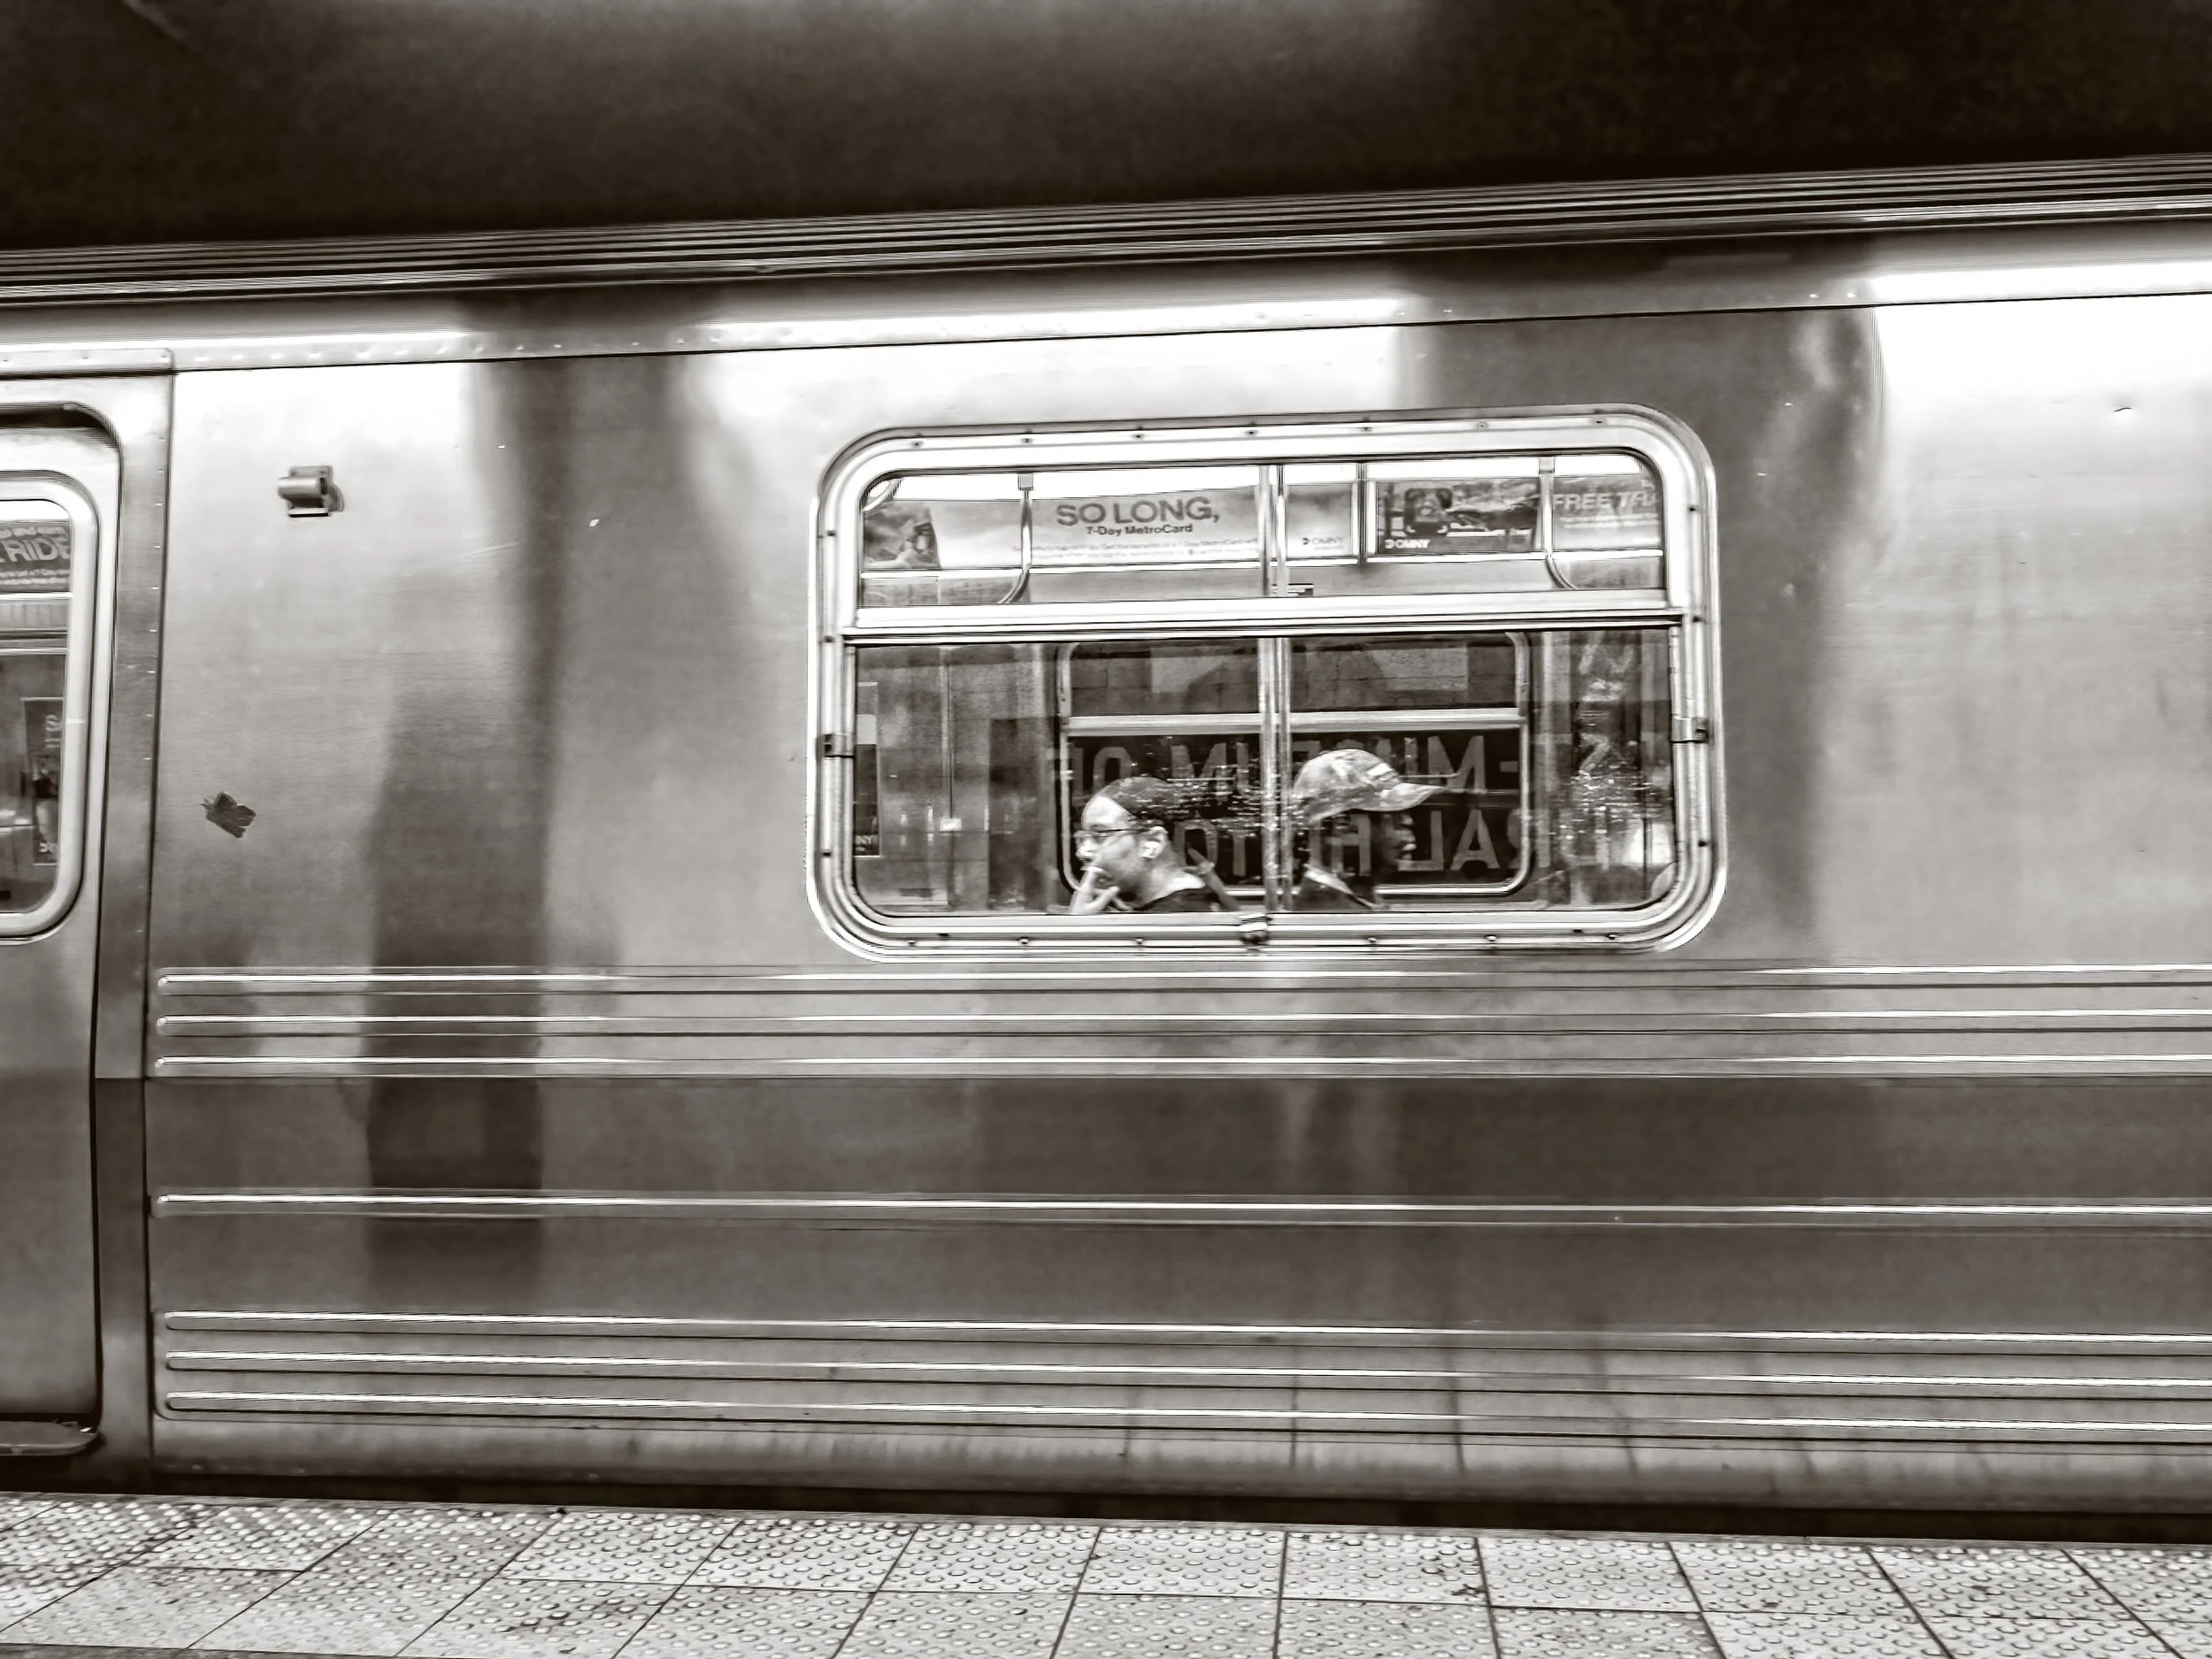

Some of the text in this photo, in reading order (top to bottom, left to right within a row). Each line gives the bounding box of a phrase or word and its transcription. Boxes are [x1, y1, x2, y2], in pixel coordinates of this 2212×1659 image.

[1056, 495, 1221, 526] SO LONG,
[1553, 492, 1612, 511] FREE
[1087, 523, 1194, 536] 7-Day MetroCard
